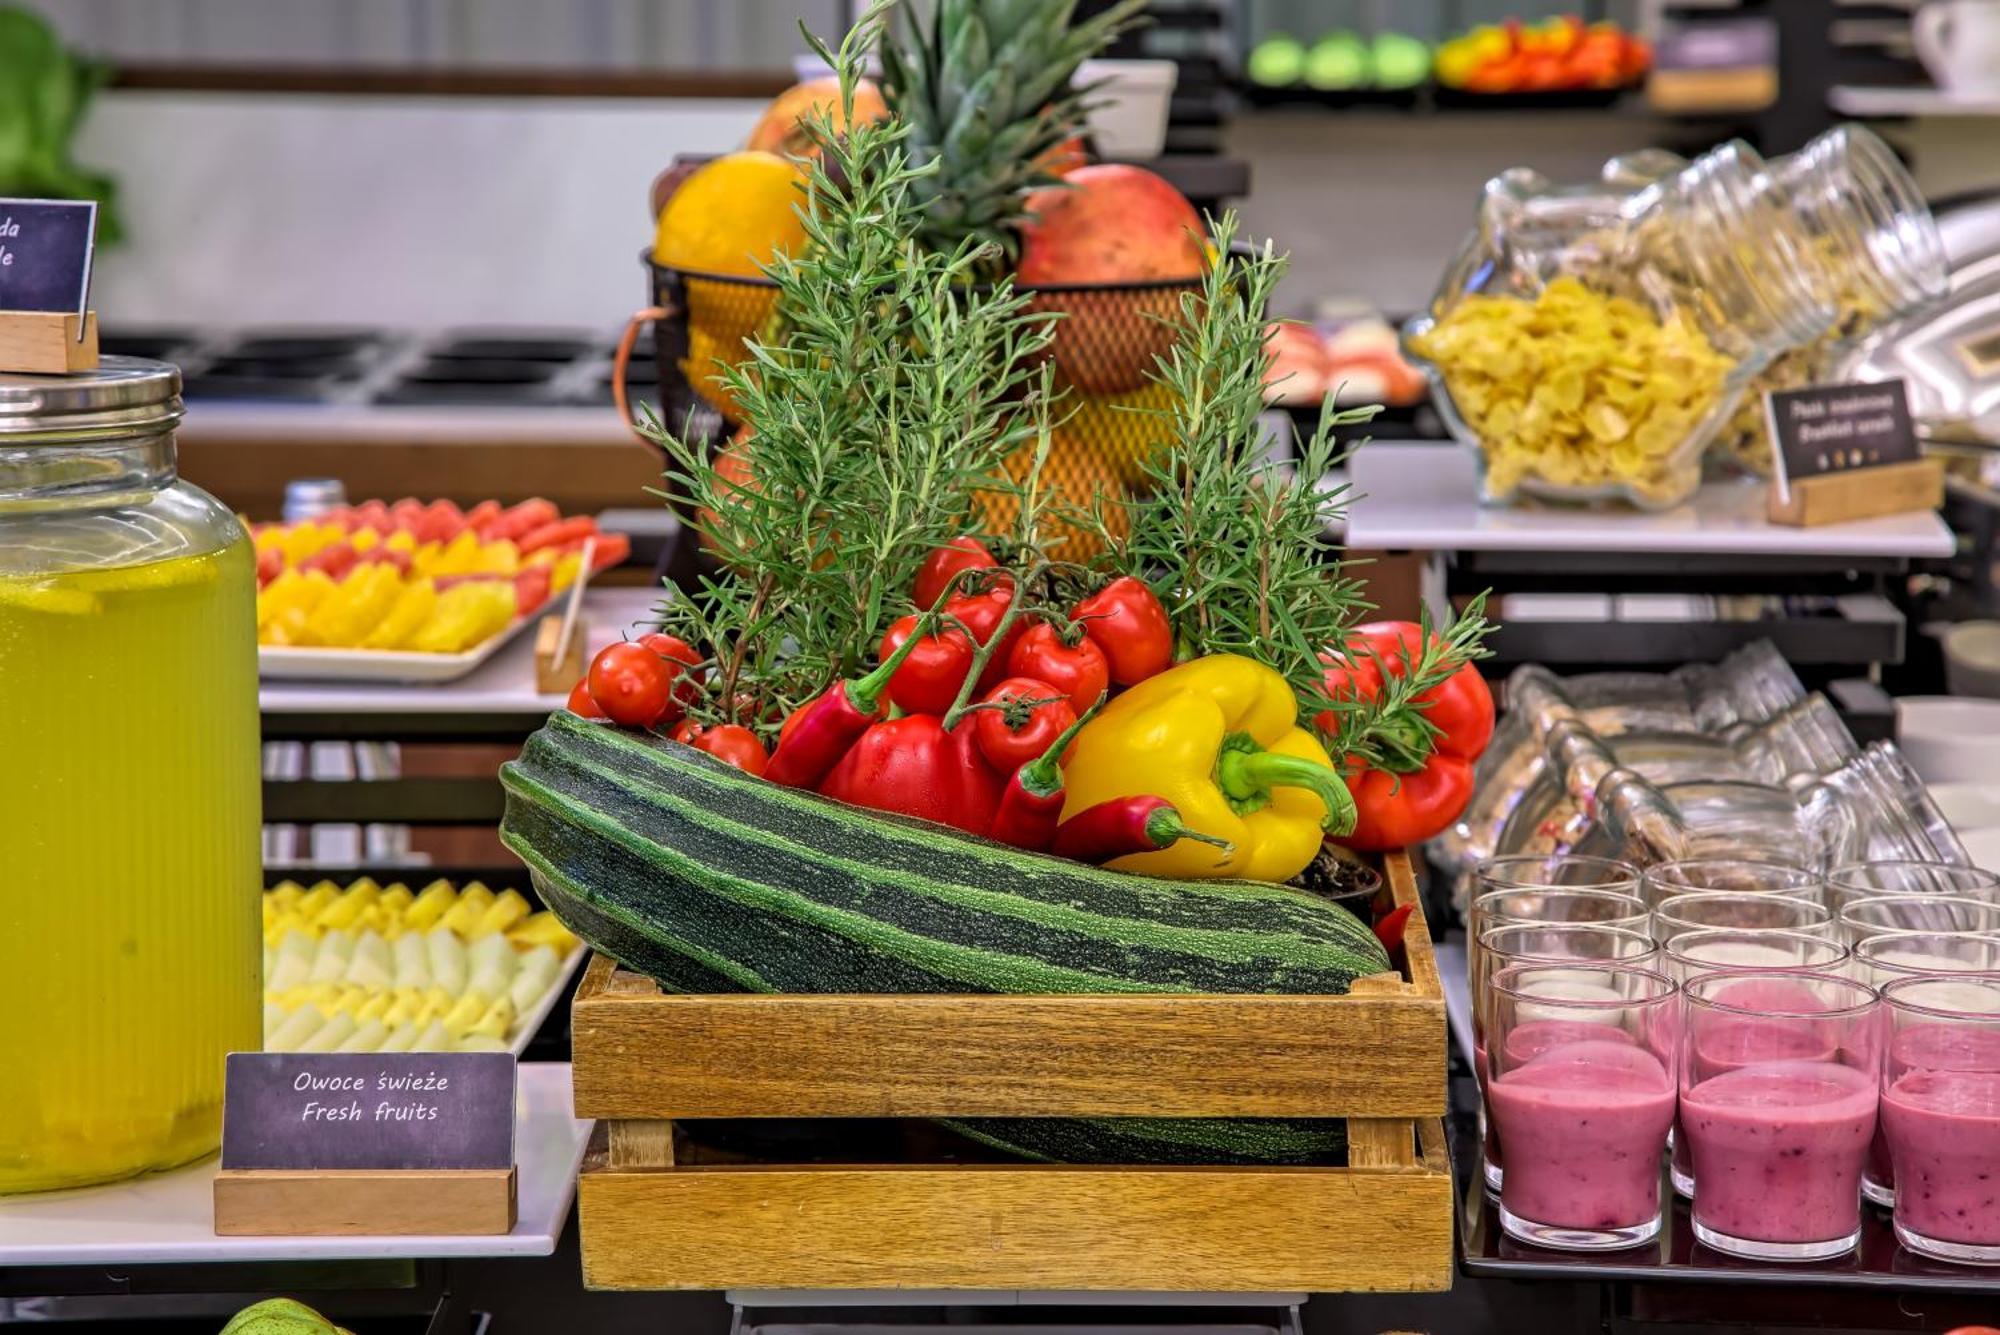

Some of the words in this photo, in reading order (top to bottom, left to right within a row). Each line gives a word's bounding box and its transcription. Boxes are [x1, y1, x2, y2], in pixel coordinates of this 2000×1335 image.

[294, 1072, 365, 1091] Owoce
[377, 1071, 448, 1091] świeże
[302, 1100, 362, 1121] Fresh
[375, 1101, 438, 1121] fruits
